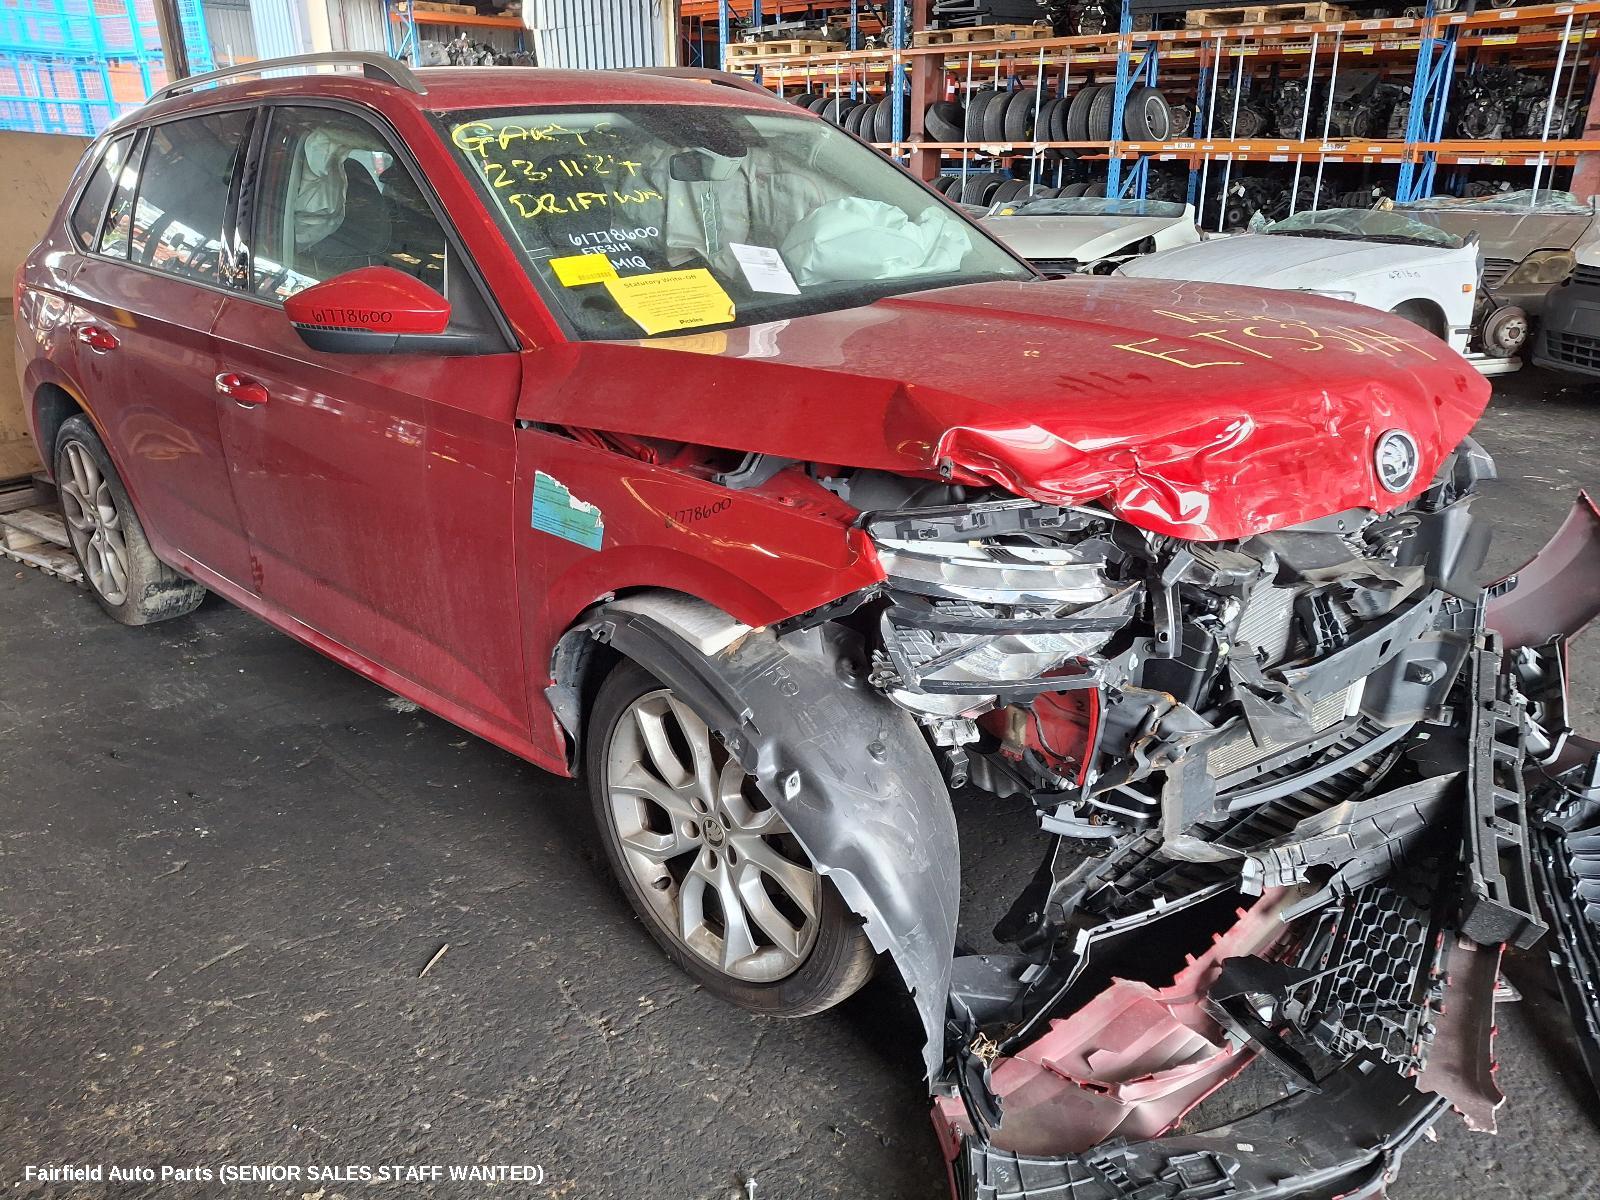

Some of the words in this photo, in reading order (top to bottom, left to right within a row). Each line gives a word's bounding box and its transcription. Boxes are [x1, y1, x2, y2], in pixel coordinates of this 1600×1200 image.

[569, 226, 659, 246] 61778600
[611, 255, 652, 270] MIQ
[624, 279, 662, 289] Statutory
[312, 309, 393, 323] 61778600
